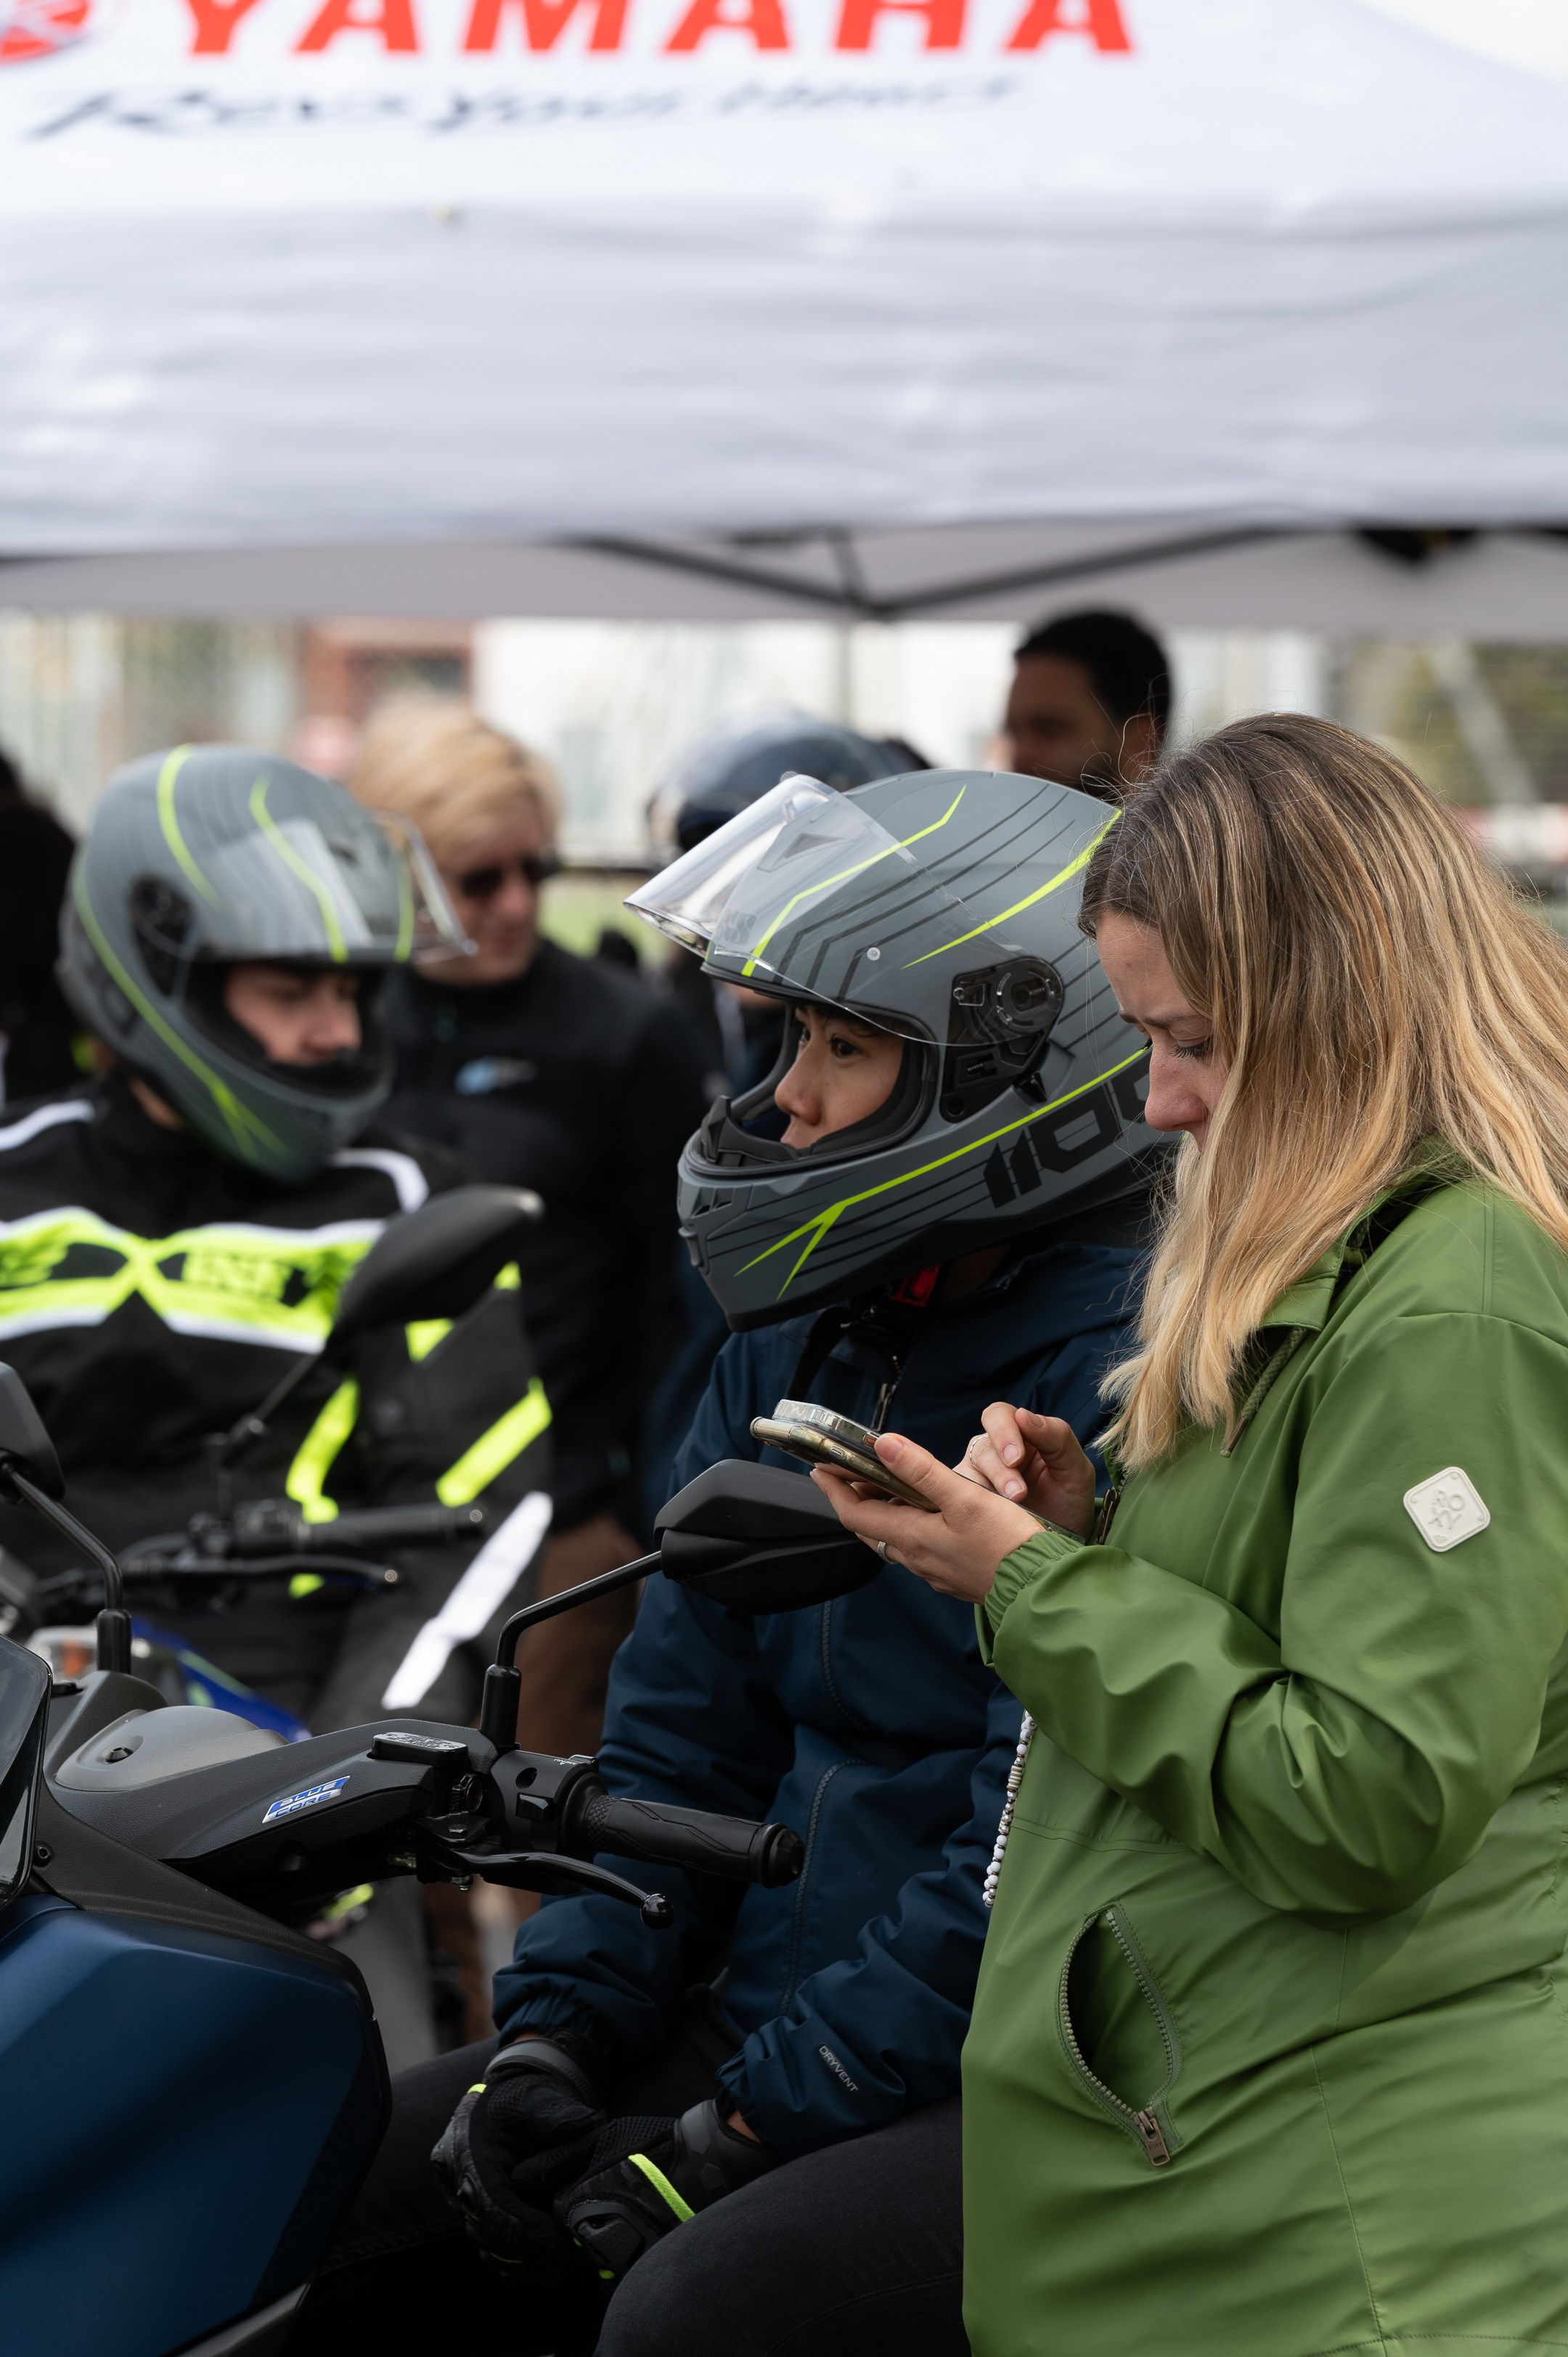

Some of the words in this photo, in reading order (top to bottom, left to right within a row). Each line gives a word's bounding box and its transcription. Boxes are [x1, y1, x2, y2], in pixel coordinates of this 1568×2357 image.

[186, 0, 1135, 55] YAMAHA
[275, 1792, 332, 1817] CORE
[279, 1781, 337, 1807] BLUE
[819, 2045, 859, 2091] DRYVENT
